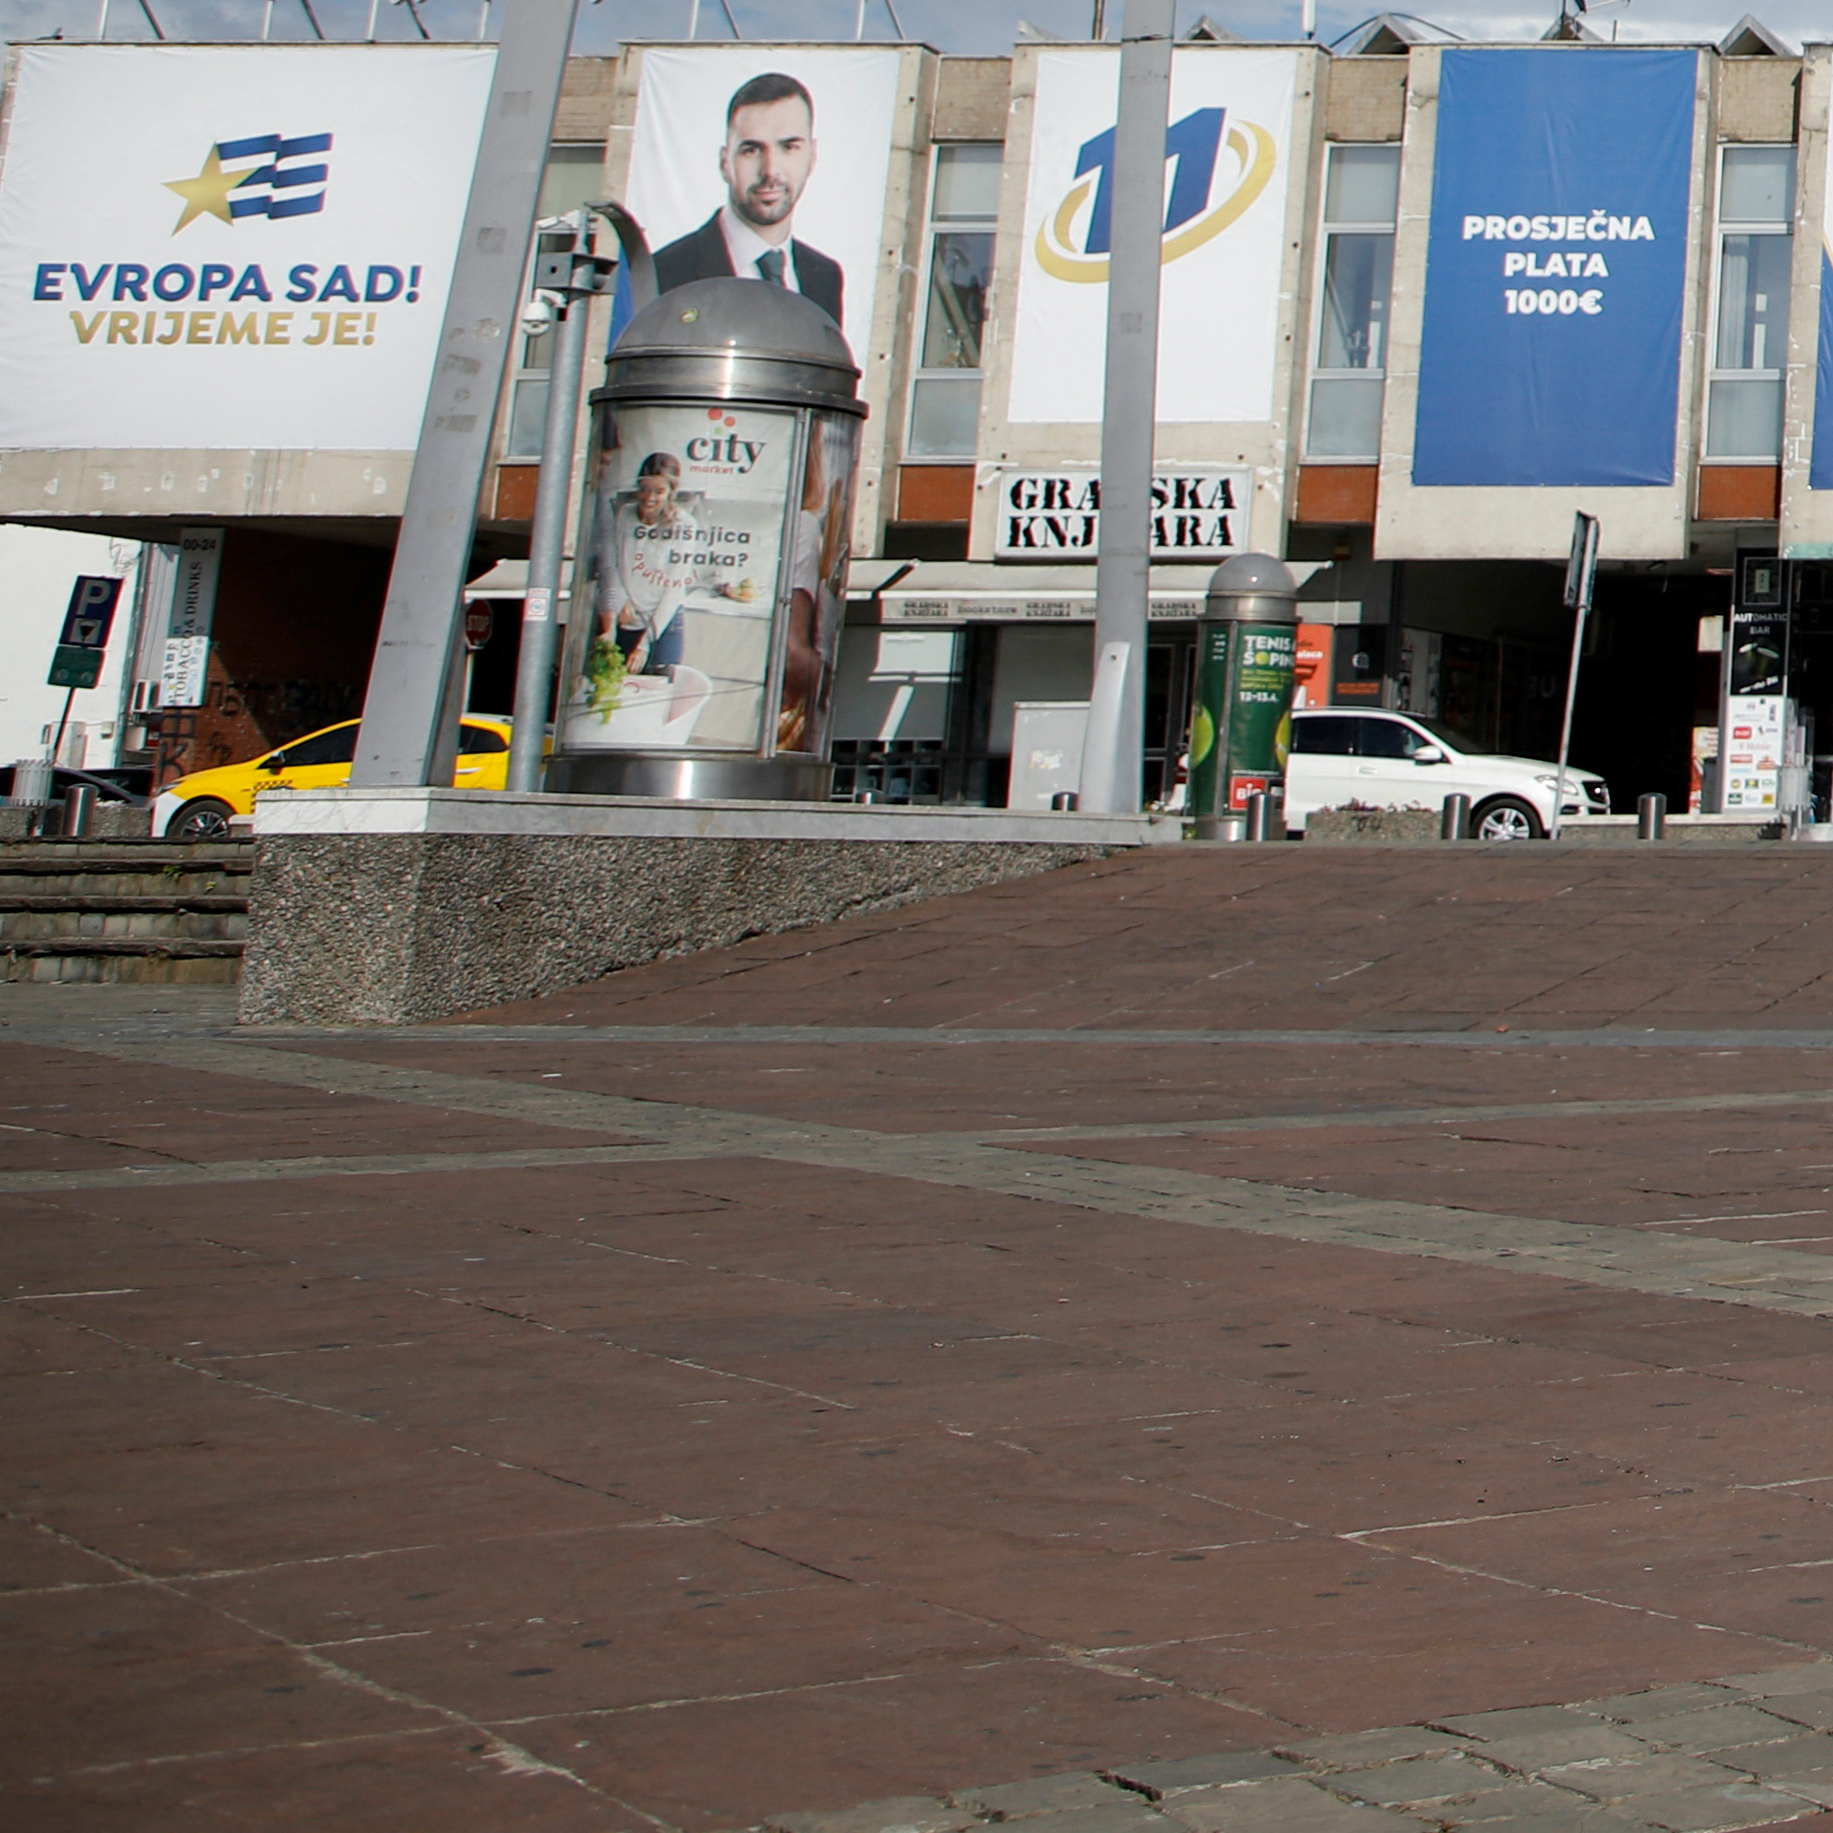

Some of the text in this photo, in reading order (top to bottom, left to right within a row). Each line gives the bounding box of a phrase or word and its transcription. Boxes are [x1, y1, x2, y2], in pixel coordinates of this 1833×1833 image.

[1463, 210, 1654, 242] PROSJEČNA
[1504, 252, 1609, 278] PLATA
[33, 262, 423, 304] EVROPA SAD!
[1504, 289, 1604, 316] 1000€
[68, 310, 378, 347] VRIJEME JE!
[687, 428, 768, 474] city
[689, 465, 735, 475] market
[1010, 477, 1237, 510] GRASKA
[633, 526, 751, 547] Godišnjica
[1008, 515, 1236, 548] KNJARA
[669, 550, 749, 567] braka?
[76, 579, 112, 616] P
[1734, 612, 1789, 622] AUTOMATIC
[1244, 635, 1291, 652] TENIS
